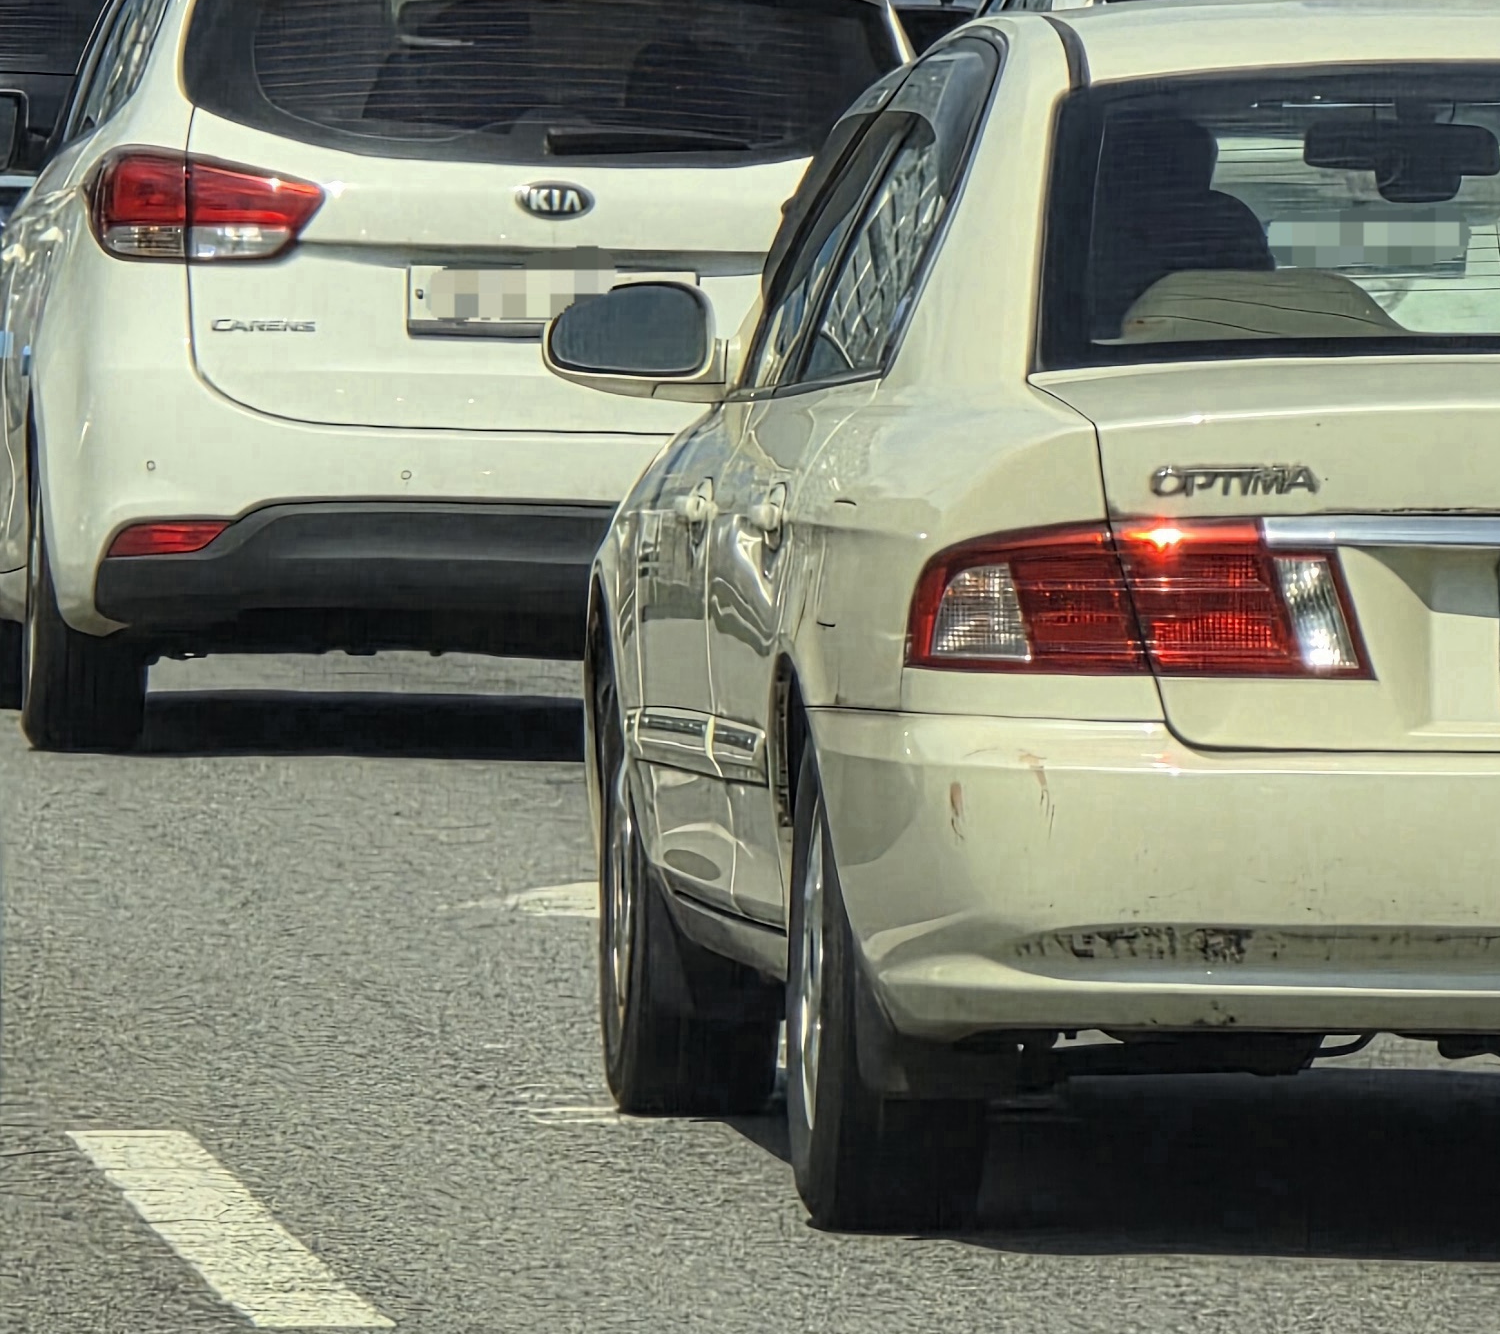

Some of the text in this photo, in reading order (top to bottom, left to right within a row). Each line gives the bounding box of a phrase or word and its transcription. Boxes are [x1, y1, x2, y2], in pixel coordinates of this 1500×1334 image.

[529, 188, 583, 212] KIA
[211, 317, 316, 333] CARENS
[1150, 464, 1320, 497] OPTIMA
